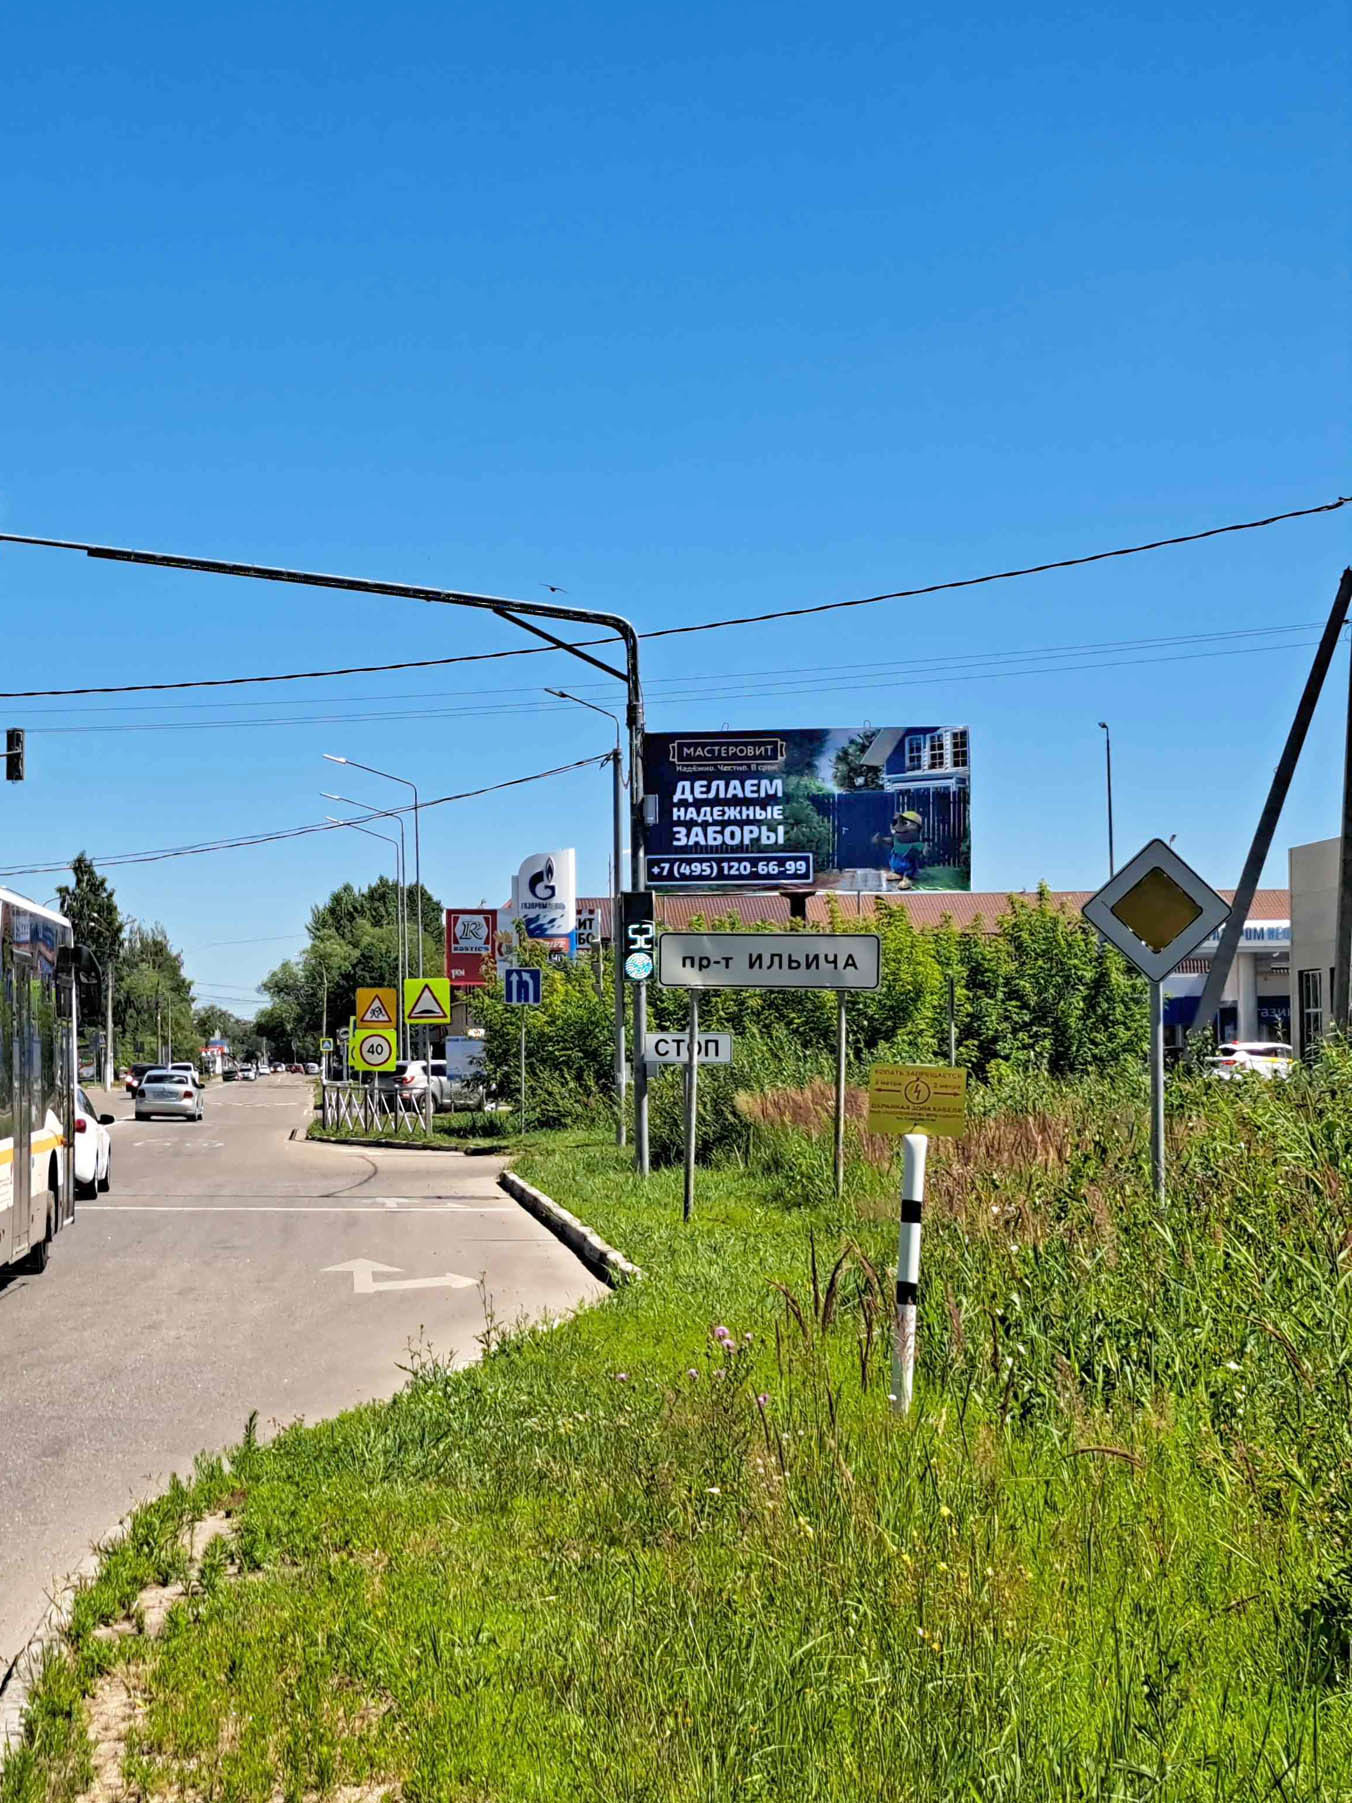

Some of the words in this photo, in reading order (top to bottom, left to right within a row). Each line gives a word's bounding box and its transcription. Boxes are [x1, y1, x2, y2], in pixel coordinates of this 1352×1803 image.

[682, 745, 774, 757] МАСТЕРОВИТ
[672, 779, 783, 803] ДЕЛАЕМ
[672, 806, 784, 822] НАДЕЖНЫЕ
[672, 825, 785, 846] ЗАБОРЫ
[651, 863, 670, 876] +7
[674, 861, 718, 878] (495)
[721, 860, 807, 875] 120-66-99
[682, 956, 734, 971] пр-т
[748, 953, 859, 971] ИЛЬИЧА
[367, 1043, 384, 1056] 40
